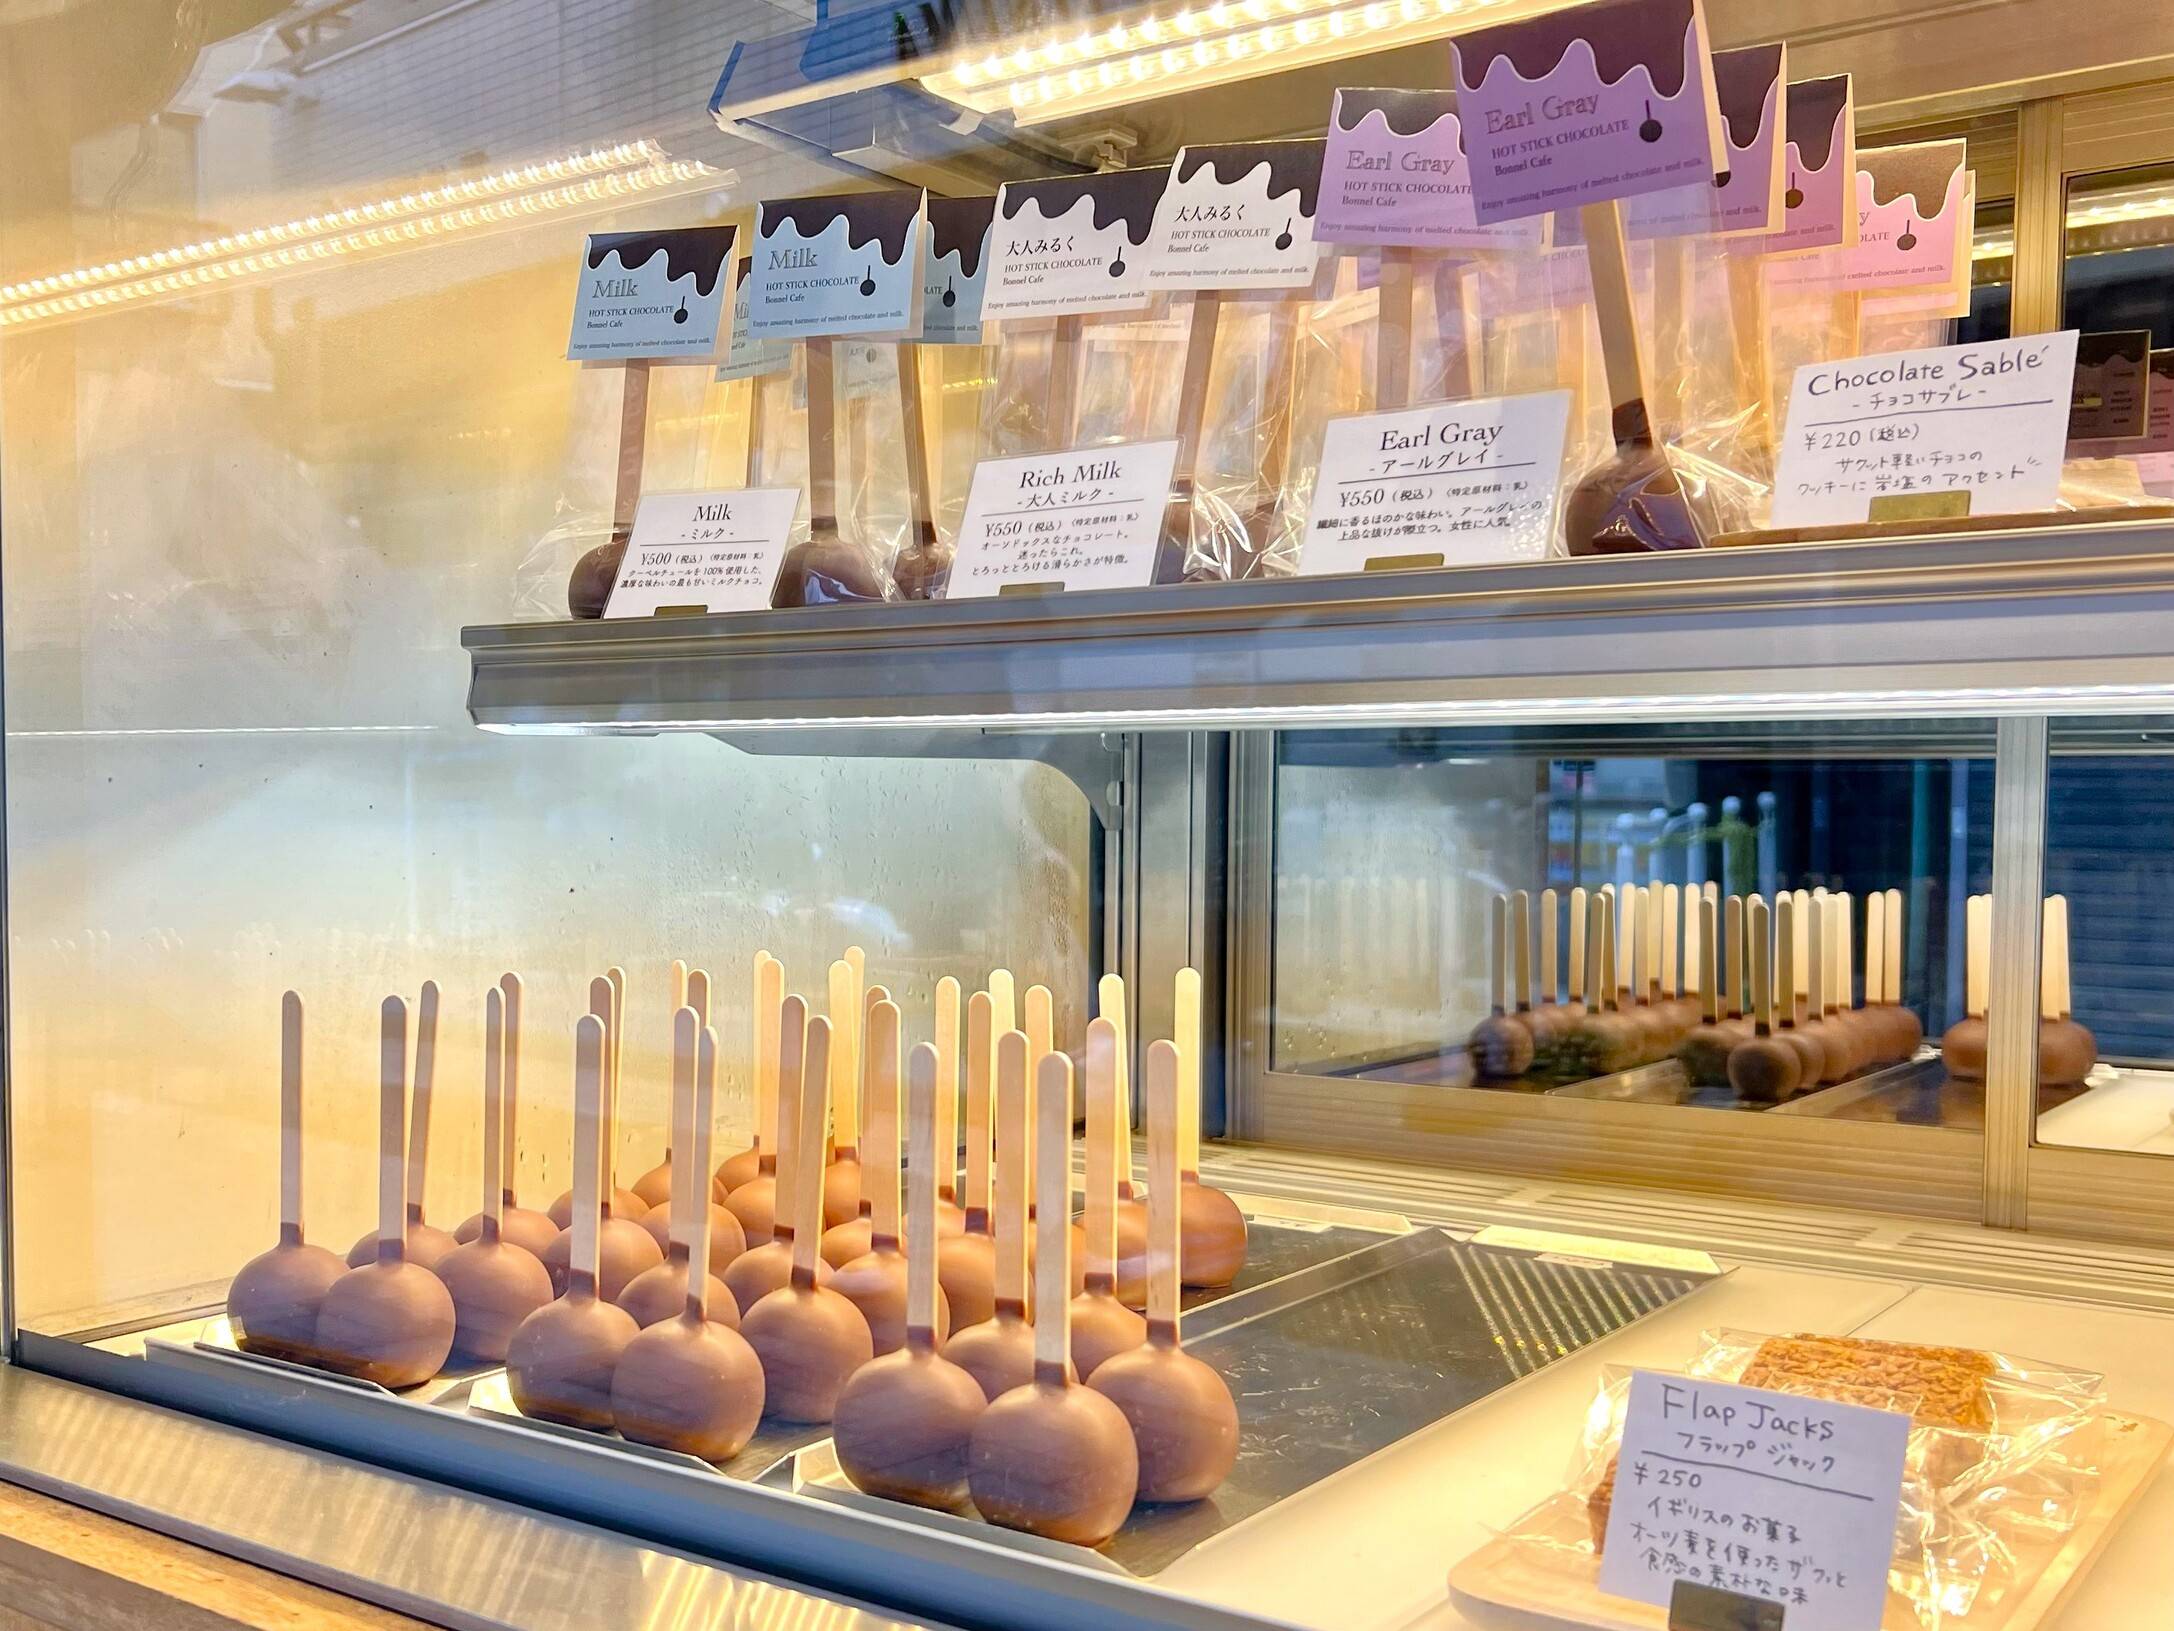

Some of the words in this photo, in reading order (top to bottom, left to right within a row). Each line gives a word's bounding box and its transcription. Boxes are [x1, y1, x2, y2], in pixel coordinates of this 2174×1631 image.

[1485, 102, 1534, 135] Earl
[1542, 94, 1599, 121] Gray
[1492, 144, 1517, 159] HOT
[1520, 137, 1554, 153] STICK
[1556, 119, 1630, 145] CHOCOLATE
[1346, 150, 1392, 171] Earl
[1401, 151, 1456, 175] Gray
[1495, 161, 1528, 176] Bonnel
[1530, 155, 1553, 169] Cafe
[1580, 180, 1589, 189] of
[1591, 175, 1619, 188] melted
[1621, 166, 1662, 181] chocolate
[1665, 161, 1681, 172] and
[1344, 181, 1367, 192] HOT
[1371, 182, 1402, 192] STICK
[1342, 195, 1373, 206] Bonnel
[1376, 197, 1397, 207] Cafe
[1174, 204, 1245, 223] 大人みるく
[1171, 231, 1190, 240] HOT
[1191, 230, 1216, 240] STICK
[1217, 228, 1271, 239] CHOCOLATE
[1320, 222, 1343, 231] Enjoy
[1377, 224, 1412, 234] harmony
[1415, 225, 1424, 233] of
[1424, 226, 1452, 234] melted
[1454, 226, 1491, 236] chocolate
[1006, 235, 1075, 257] 大人みるく
[1167, 244, 1192, 253] Bonnel
[1193, 244, 1210, 253] Cafe
[768, 247, 818, 271] Milk
[1004, 263, 1022, 273] HOT
[1024, 261, 1049, 272] STICK
[1050, 257, 1103, 270] CHOCOLATE
[1911, 266, 1926, 274] and
[592, 278, 639, 299] Milk
[766, 283, 784, 292] HOT
[785, 280, 808, 290] STICK
[810, 276, 859, 288] CHOCOLATE
[1003, 276, 1027, 286] Bonnel
[1028, 275, 1044, 284] Cafe
[765, 295, 788, 304] Bonnel
[789, 294, 805, 303] Cafe
[1087, 294, 1117, 302] chocolate
[588, 309, 605, 318] HOT
[607, 307, 628, 316] STICK
[629, 305, 675, 316] CHOCOLATE
[848, 313, 876, 321] chocolate
[877, 311, 889, 319] and
[586, 320, 608, 329] Bonnel
[610, 320, 624, 328] Cafe
[660, 338, 686, 346] chocolate
[1808, 360, 1944, 396] Chocolate
[1958, 345, 2049, 380] Sablé
[1380, 425, 1430, 451] Earl
[1440, 422, 1504, 446] Gray
[1019, 466, 1065, 490] Rich
[1071, 460, 1122, 484] Milk
[1341, 488, 1384, 507] ¥550
[692, 503, 733, 522] Milk
[985, 521, 1022, 538] ¥550
[641, 552, 672, 566] ¥500
[1017, 547, 1084, 561] 迷ったらこれ。
[1662, 1383, 1736, 1427] Flap
[1746, 1401, 1835, 1441] Jacks
